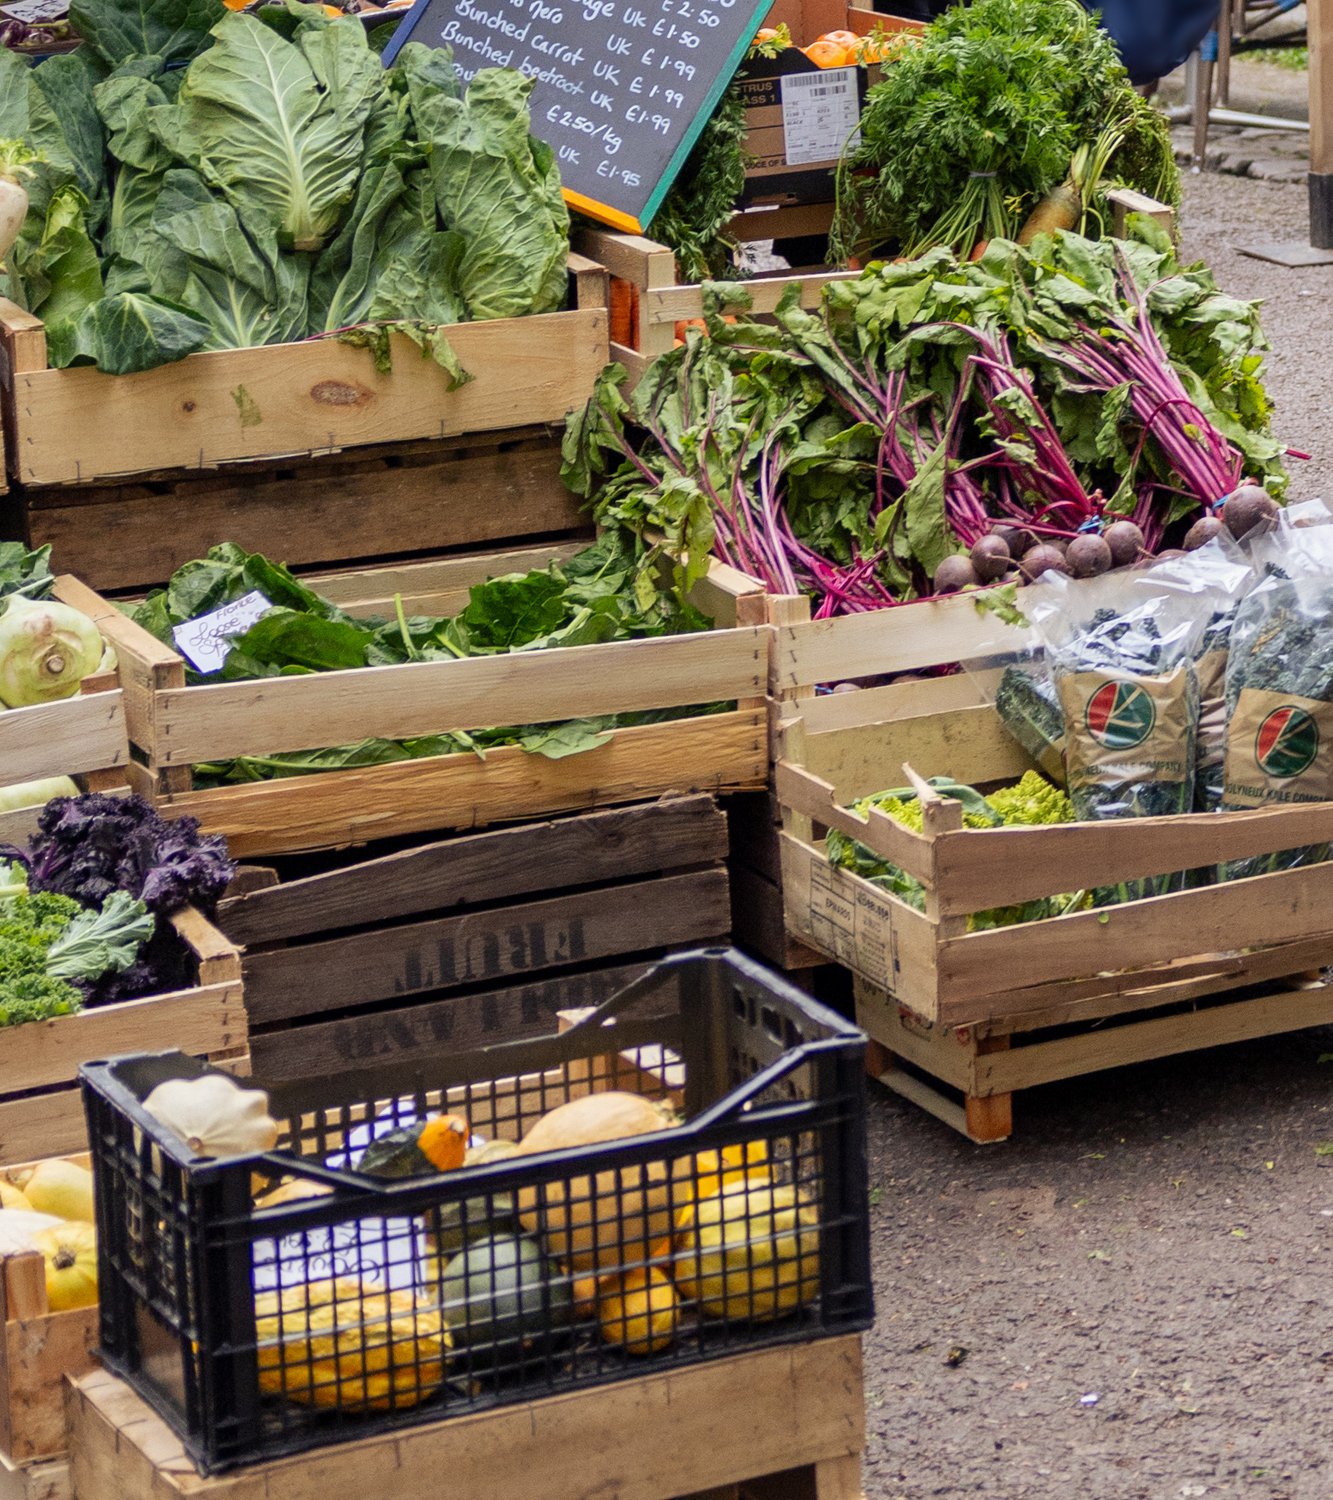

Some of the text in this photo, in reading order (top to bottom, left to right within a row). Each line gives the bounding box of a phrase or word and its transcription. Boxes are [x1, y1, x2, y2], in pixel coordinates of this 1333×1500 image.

[622, 10, 647, 28] UK
[605, 33, 632, 57] UK
[440, 20, 515, 68] Bunched
[518, 55, 585, 96] beetroot
[589, 90, 615, 113] UK
[530, 34, 586, 67] carrot
[592, 60, 621, 87] UK
[741, 82, 773, 94] TRUS
[744, 95, 766, 106] ASS
[558, 144, 581, 165] UK
[768, 160, 779, 168] OF
[189, 616, 242, 647] Loose
[394, 919, 586, 992] FRUIT
